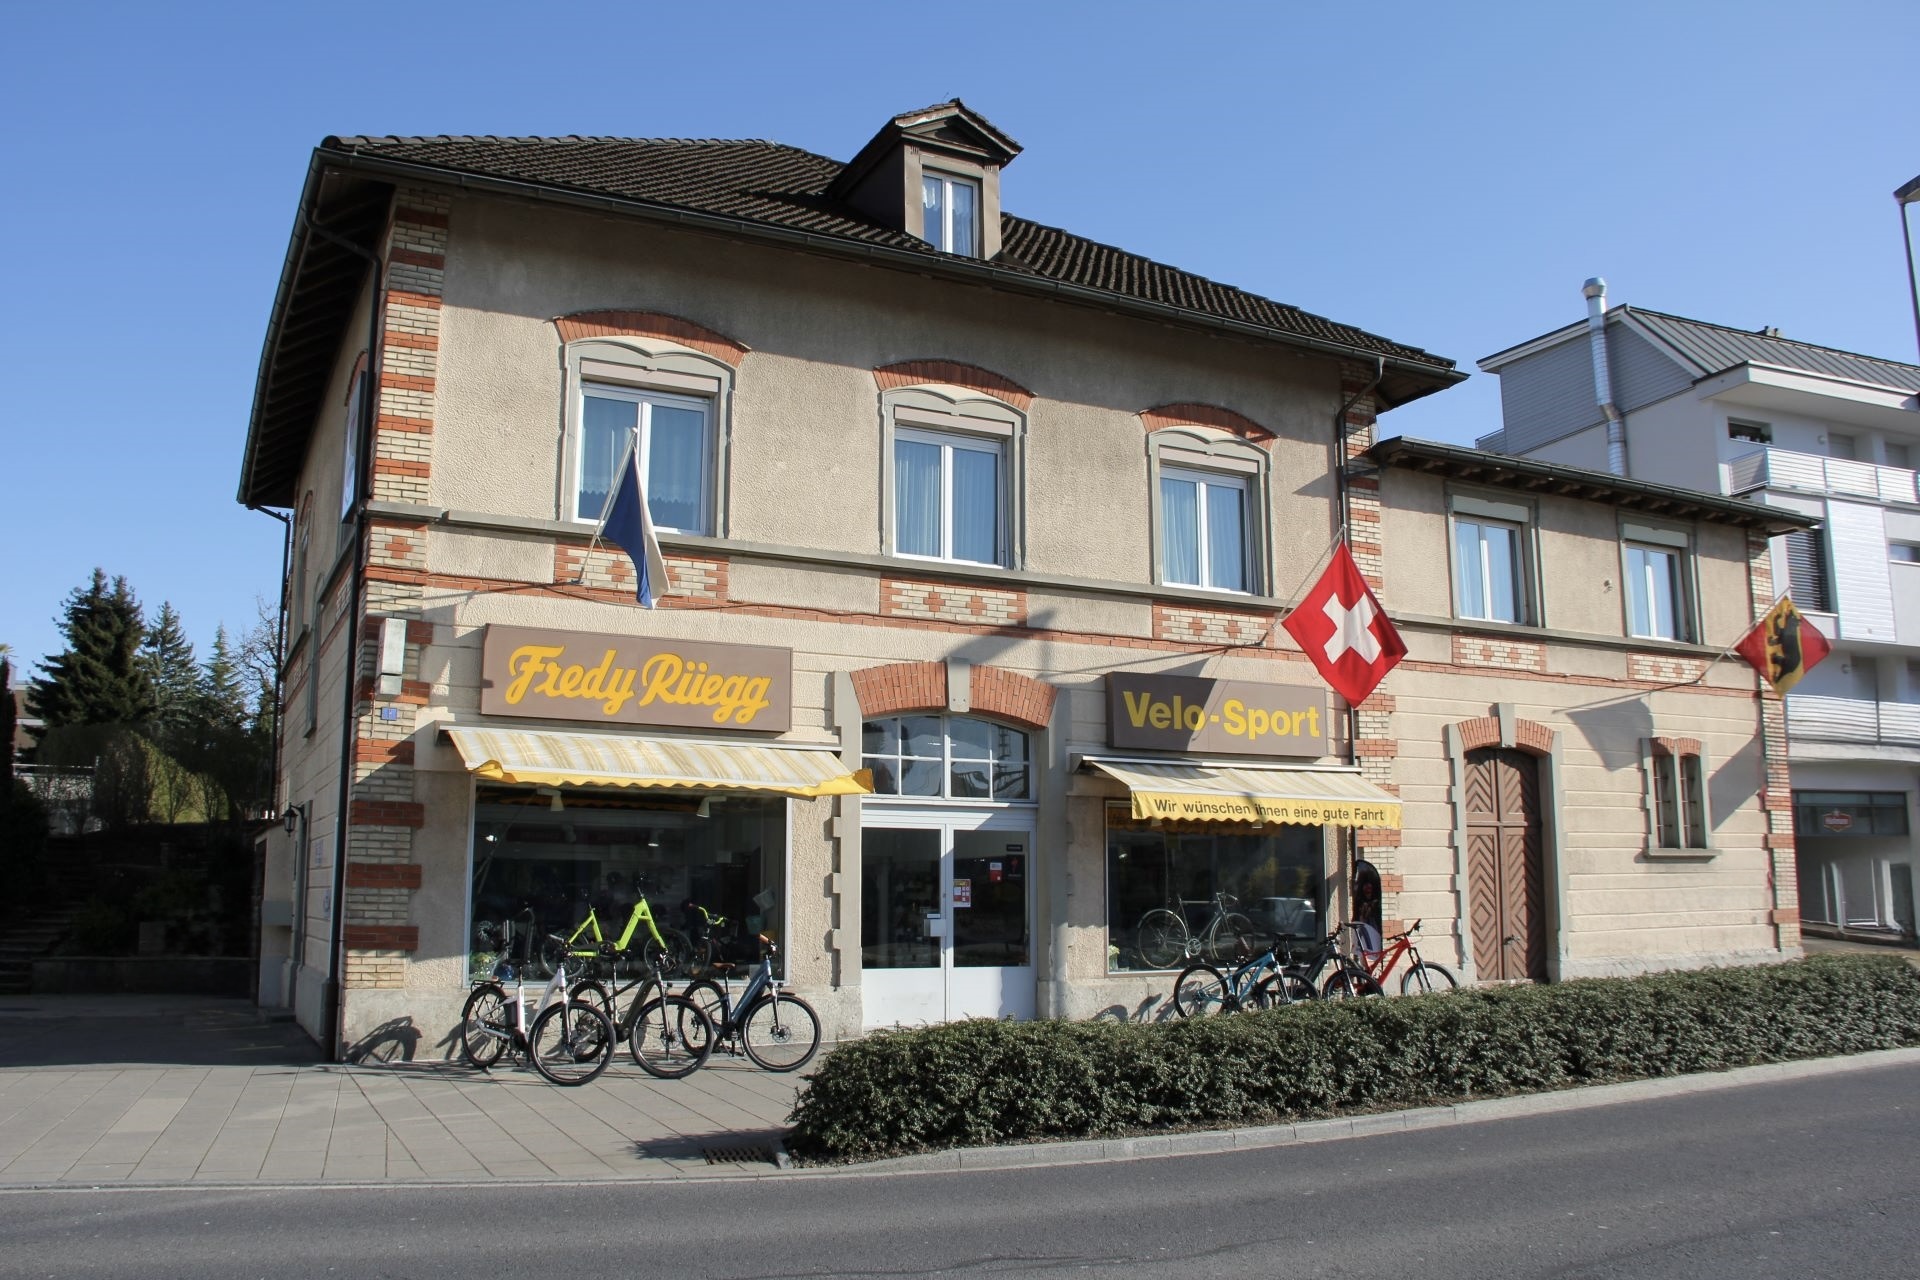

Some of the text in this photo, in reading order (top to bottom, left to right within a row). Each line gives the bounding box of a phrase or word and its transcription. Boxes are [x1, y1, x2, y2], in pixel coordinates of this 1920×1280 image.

[505, 644, 771, 724] Fredy Rüegg
[1122, 690, 1320, 740] Velo-Sport
[1154, 798, 1177, 813] Wir
[1183, 801, 1250, 816] wünschen
[1293, 806, 1318, 819] eine
[1323, 808, 1350, 822] gute
[1354, 808, 1384, 822] Fahrt
